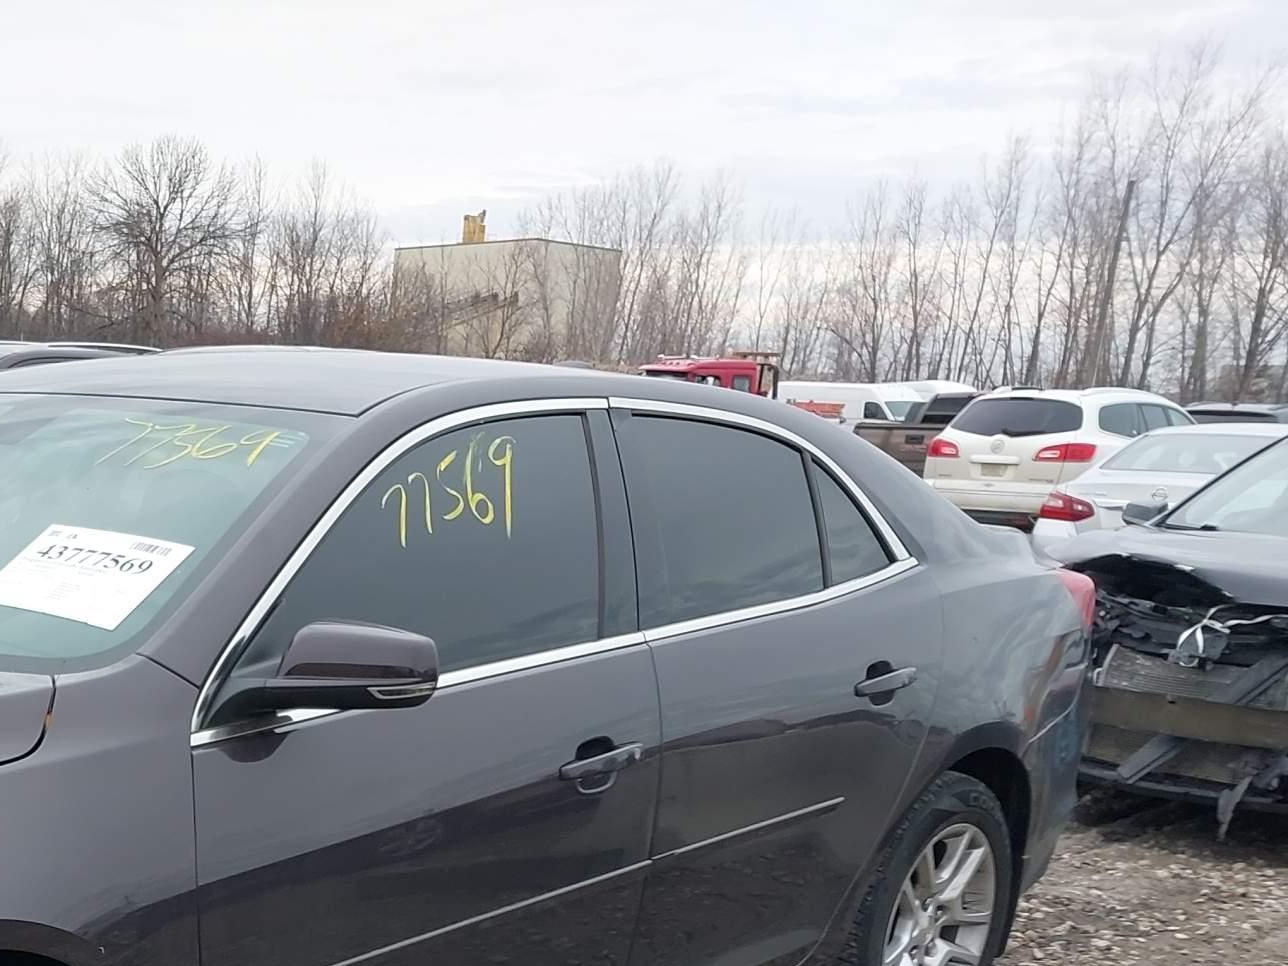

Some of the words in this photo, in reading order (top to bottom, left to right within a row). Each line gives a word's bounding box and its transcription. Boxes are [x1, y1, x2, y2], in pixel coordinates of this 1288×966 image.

[94, 418, 280, 469] 77569
[381, 432, 517, 548] 77569
[37, 544, 153, 575] 43777569
